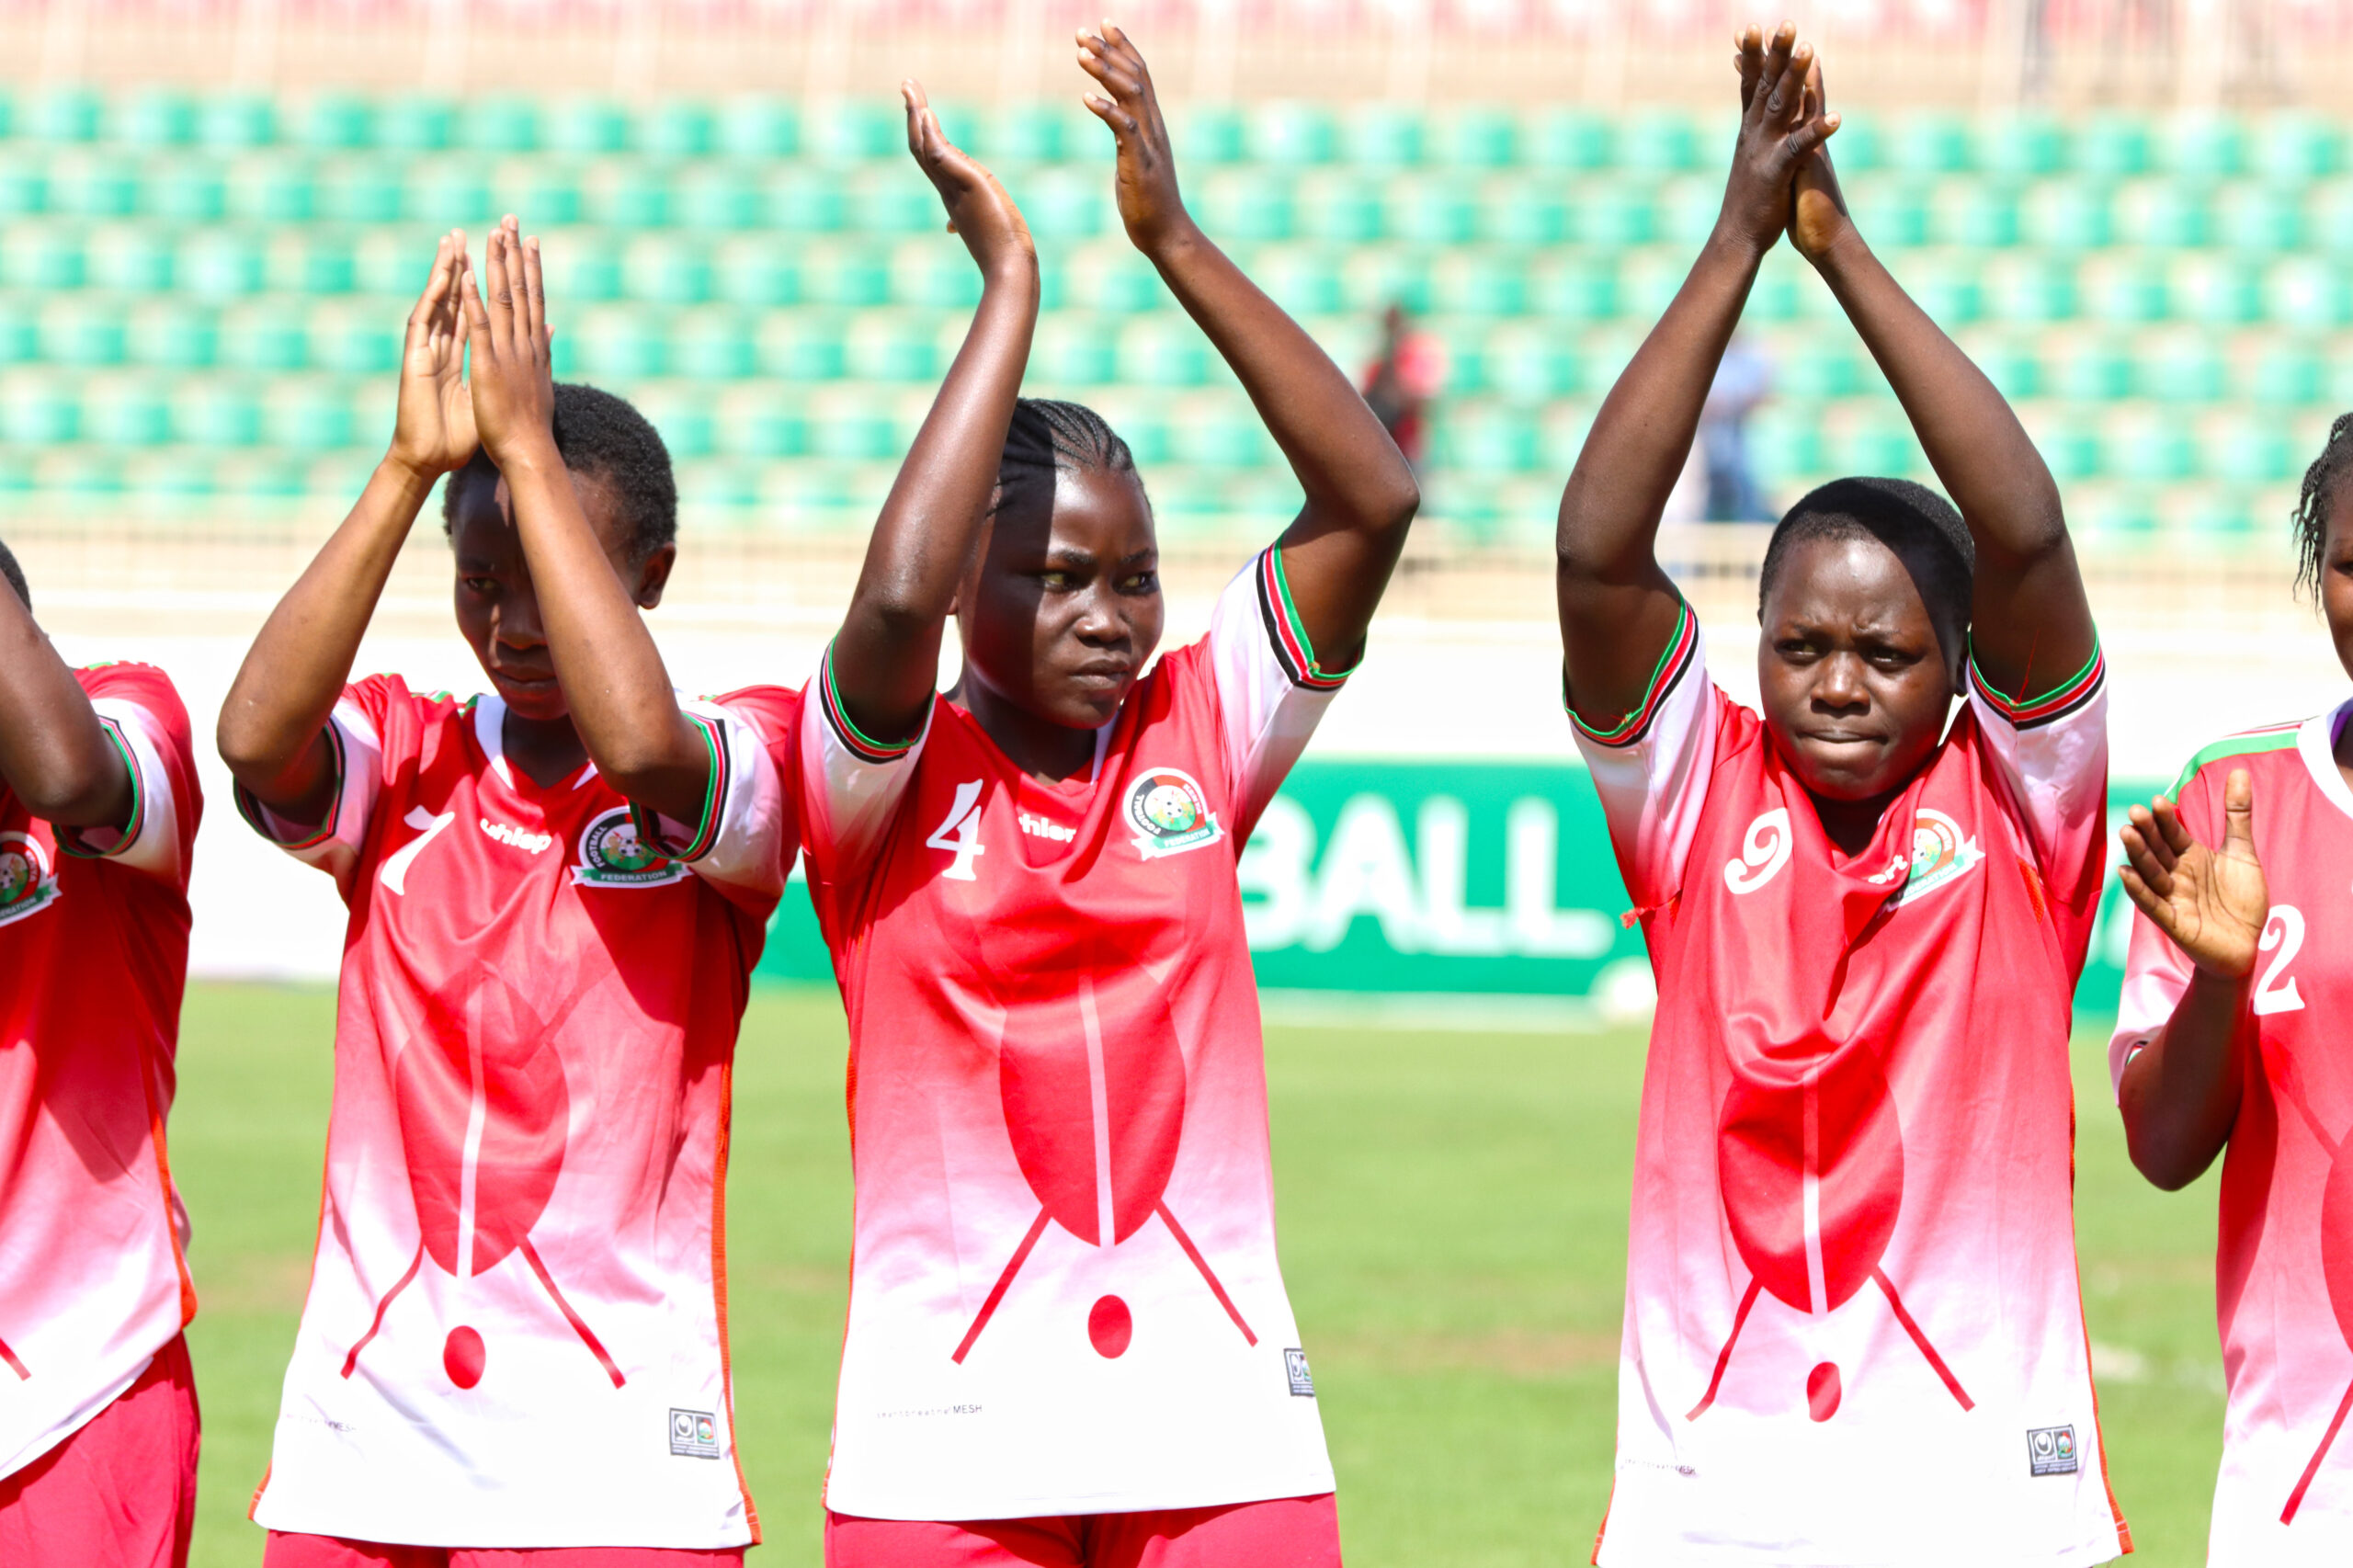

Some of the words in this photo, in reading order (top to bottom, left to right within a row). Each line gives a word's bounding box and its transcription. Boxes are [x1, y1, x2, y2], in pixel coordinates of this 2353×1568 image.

[381, 804, 456, 897] 7
[588, 825, 608, 869] FOOTBALL
[926, 778, 985, 881] 4
[1723, 807, 1793, 895] 9
[600, 869, 668, 881] FEDERATION
[2253, 904, 2306, 1016] 2
